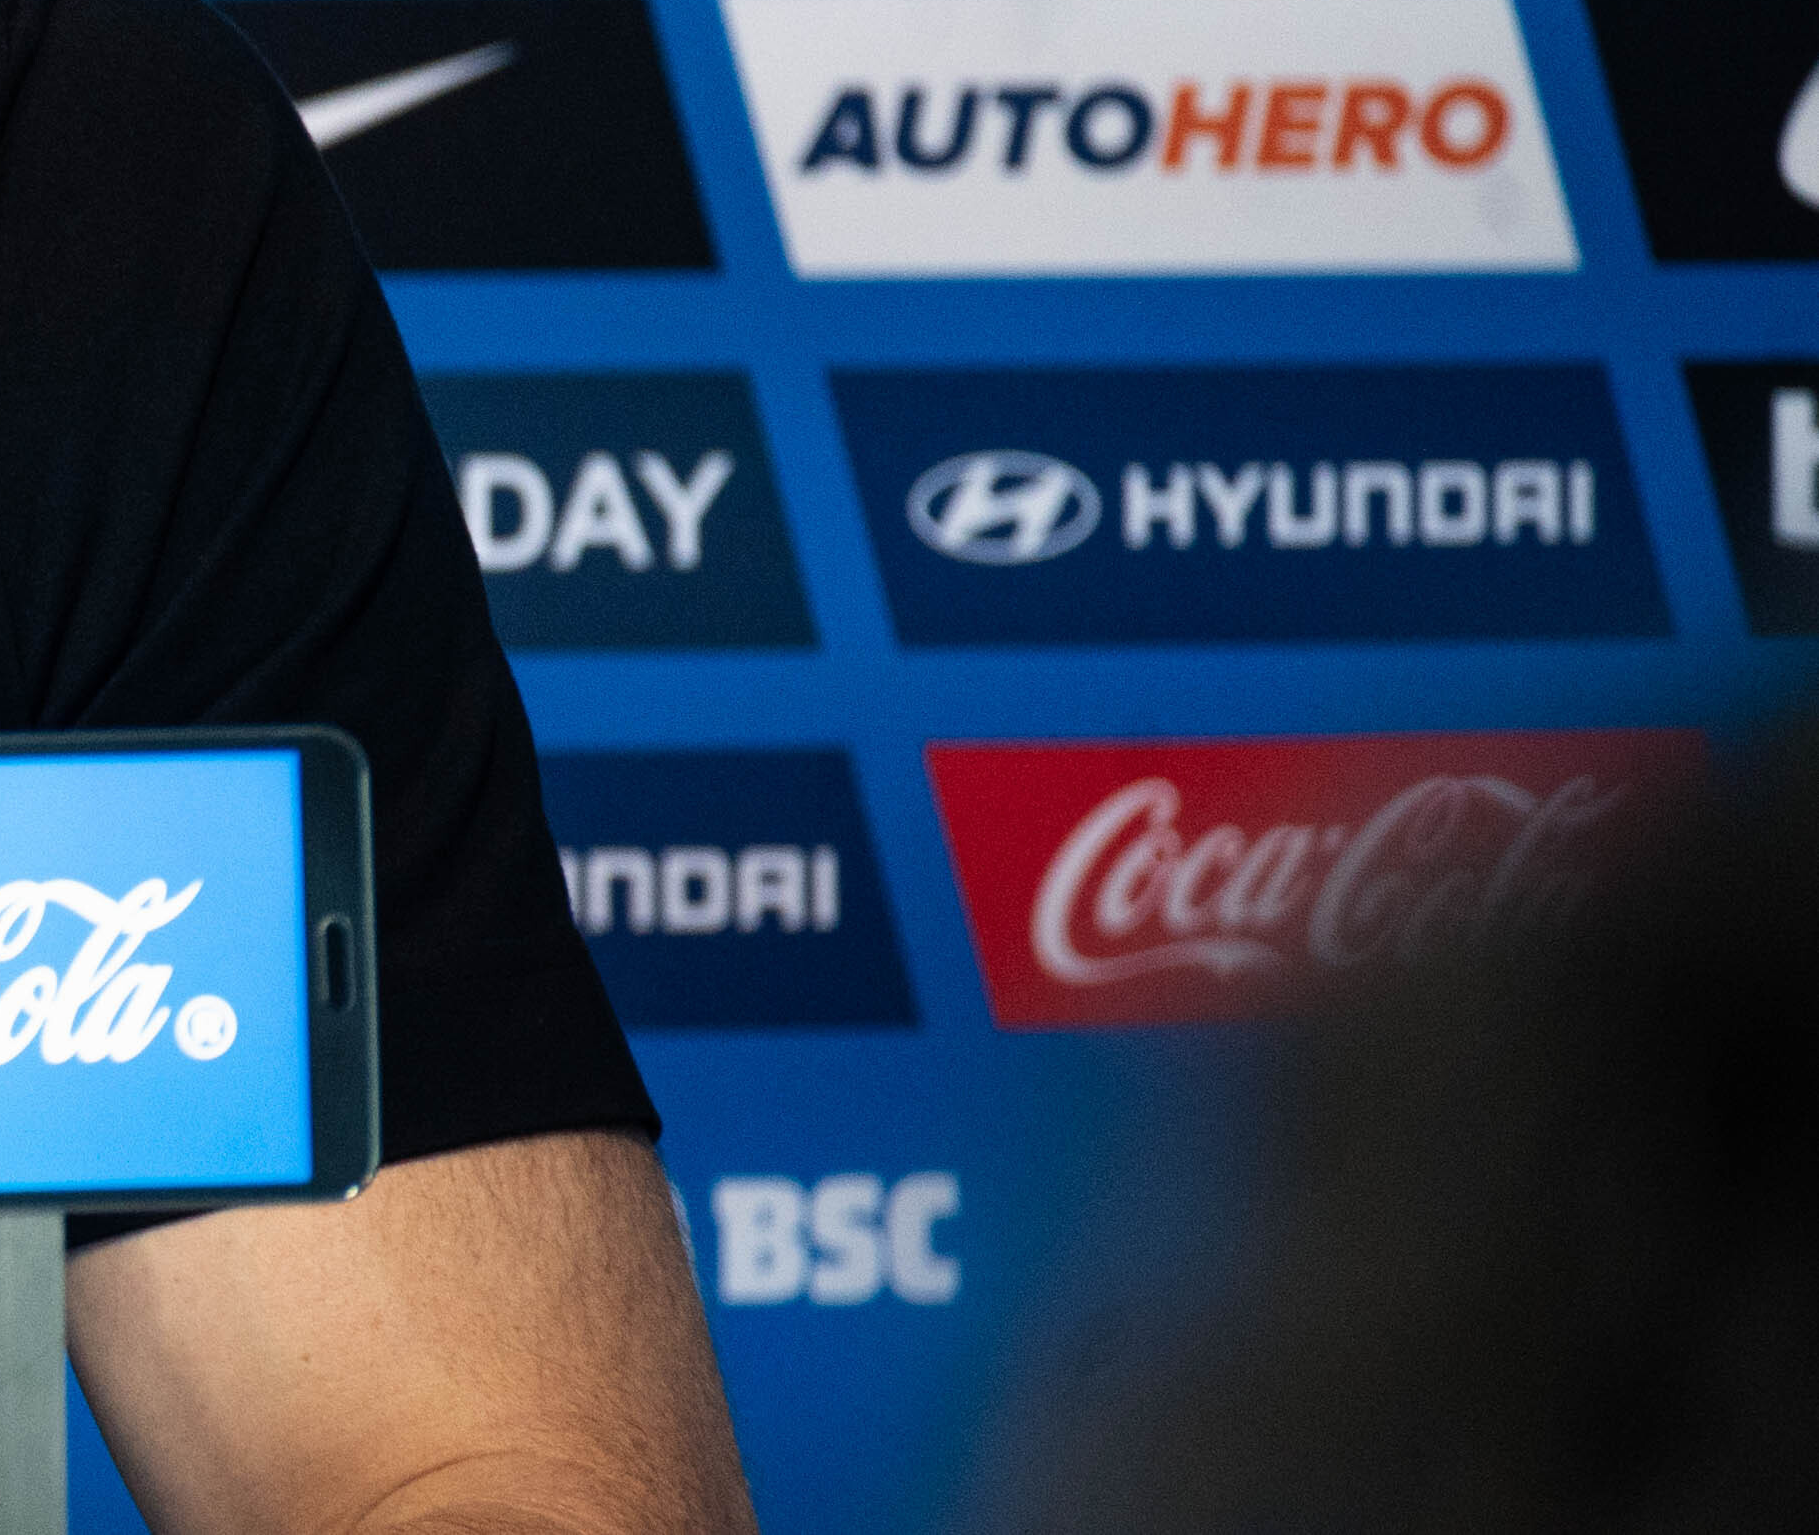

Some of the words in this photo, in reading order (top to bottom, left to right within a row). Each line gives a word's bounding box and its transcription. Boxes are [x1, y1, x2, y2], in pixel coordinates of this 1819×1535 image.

[799, 81, 1511, 174] AUTOHERO
[1122, 461, 1595, 548] HYUNDAI
[713, 1173, 959, 1305] BSC
